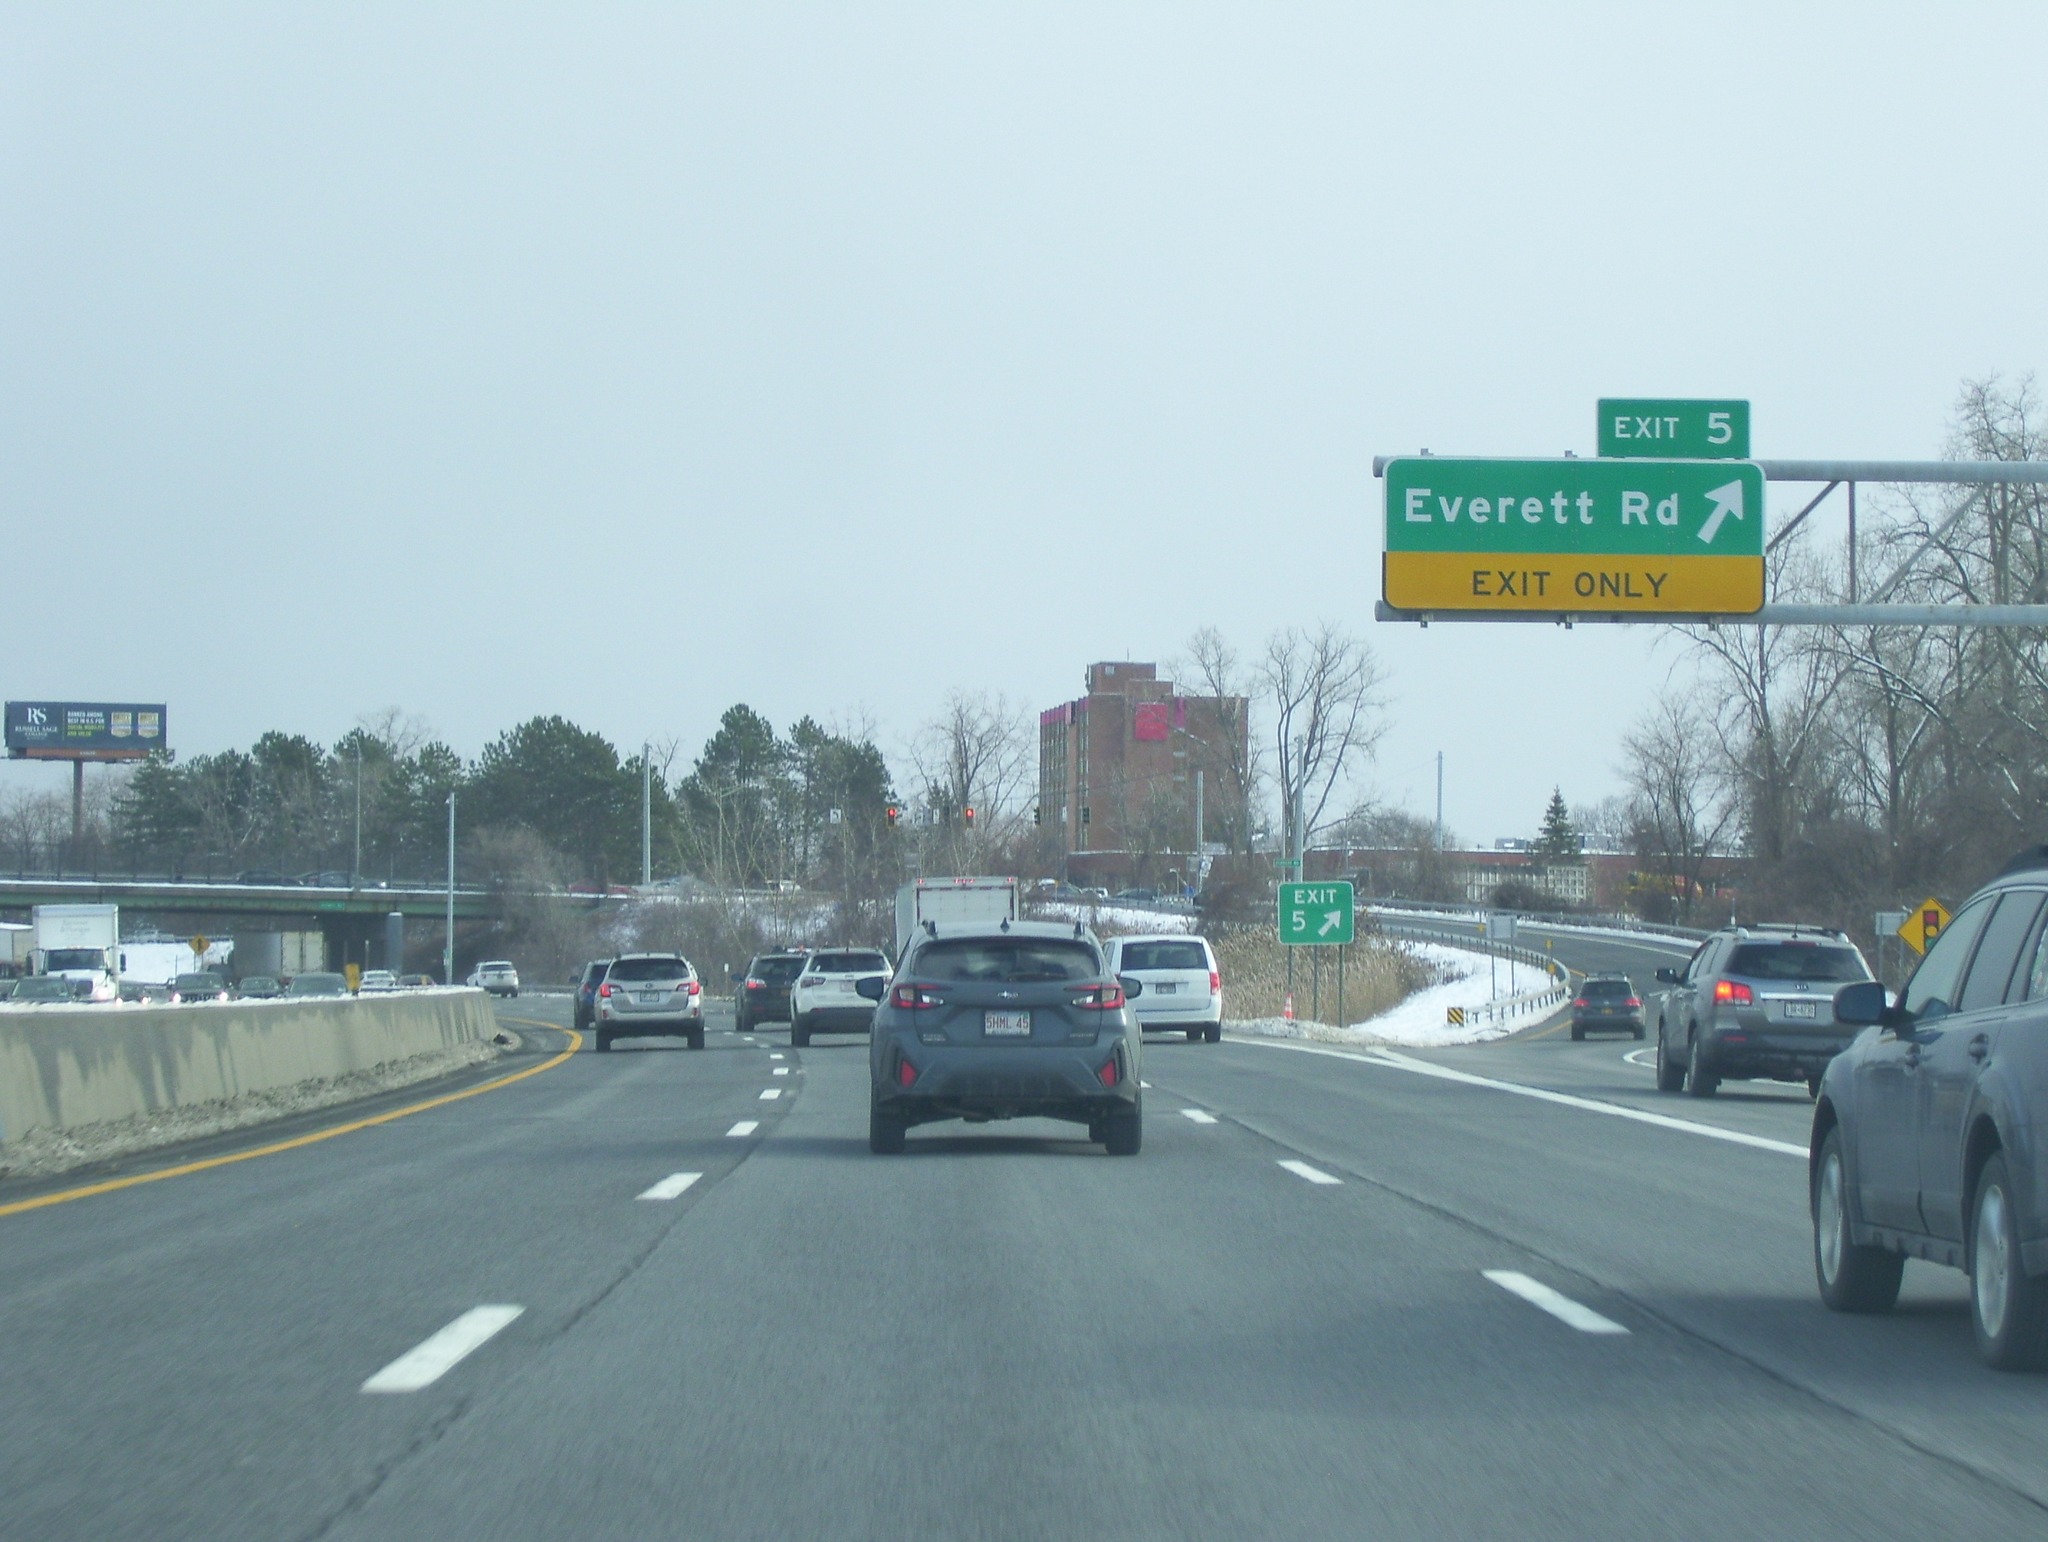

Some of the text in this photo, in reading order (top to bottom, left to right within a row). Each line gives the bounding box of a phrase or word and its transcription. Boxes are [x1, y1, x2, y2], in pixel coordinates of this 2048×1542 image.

[1614, 412, 1733, 445] EXIT 5
[1405, 488, 1679, 526] Everett Rd
[1472, 570, 1668, 598] EXIT ONLY
[27, 707, 47, 725] RS
[1294, 889, 1337, 904] EXIT
[1292, 910, 1306, 931] 5
[1016, 1016, 1029, 1029] 45
